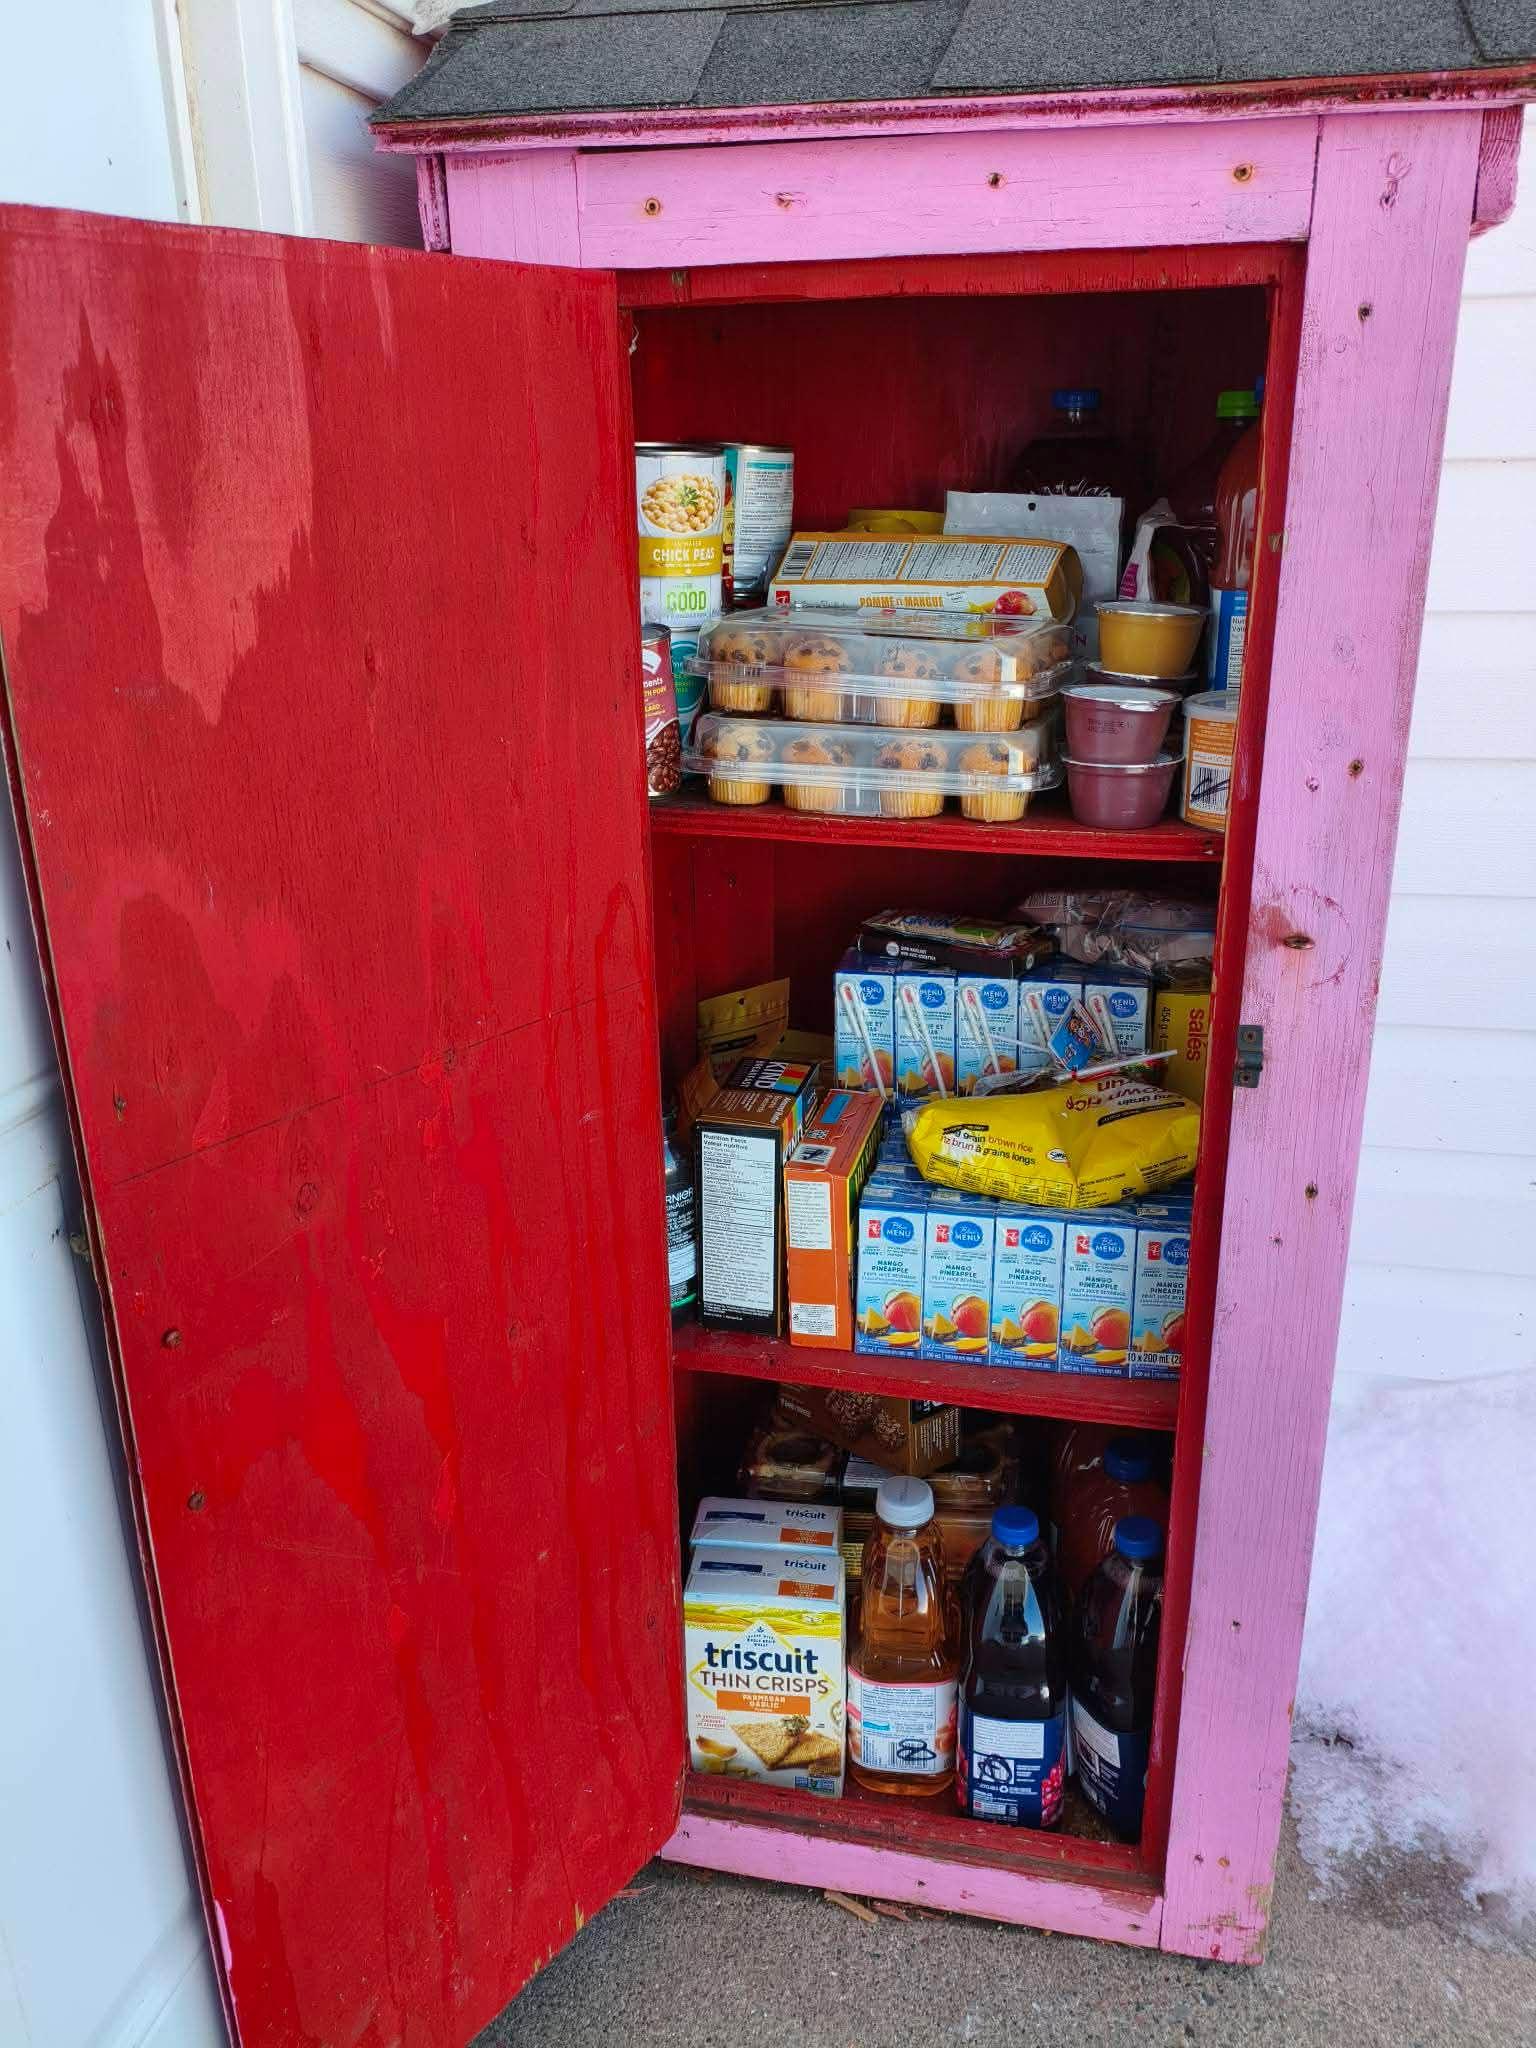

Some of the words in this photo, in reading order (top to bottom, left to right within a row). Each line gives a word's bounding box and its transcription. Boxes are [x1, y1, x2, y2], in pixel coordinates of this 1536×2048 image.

[653, 548, 690, 562] CHICK
[693, 547, 715, 561] PEAS
[666, 590, 707, 611] GOOD
[859, 595, 893, 608] POMME
[904, 594, 945, 608] MANGUE
[920, 988, 943, 997] MENU
[984, 989, 1006, 998] MENU
[1046, 995, 1070, 1003] MENU
[1111, 998, 1136, 1006] MENU
[754, 1061, 790, 1089] KIND
[704, 1134, 729, 1142] Nutrition
[963, 1131, 986, 1143] grain
[988, 1134, 1018, 1150] brown
[1017, 1143, 1034, 1154] rice
[951, 1137, 974, 1151] brun
[982, 1147, 1011, 1160] grains
[1011, 1152, 1036, 1166] longs
[886, 1229, 911, 1238] MENU
[955, 1232, 980, 1241] MENU
[1024, 1238, 1050, 1246] MENU
[1095, 1244, 1121, 1253] MENU
[871, 1265, 909, 1274] PINEAPPLE
[945, 1264, 972, 1272] MANGO
[939, 1270, 977, 1279] PINEAPPLE
[1008, 1274, 1047, 1282] PINEAPPLE
[1079, 1282, 1119, 1291] PINEAPPLE
[1150, 1287, 1184, 1295] PINEAPPL
[1143, 1353, 1157, 1362] 200
[1158, 1353, 1169, 1363] mL
[785, 1509, 827, 1520] triscuit
[784, 1559, 827, 1571] triscuit
[704, 1642, 819, 1675] triscuit
[700, 1670, 750, 1689] THIN
[756, 1676, 829, 1695] CRISPS
[749, 1701, 780, 1709] GARLIC
